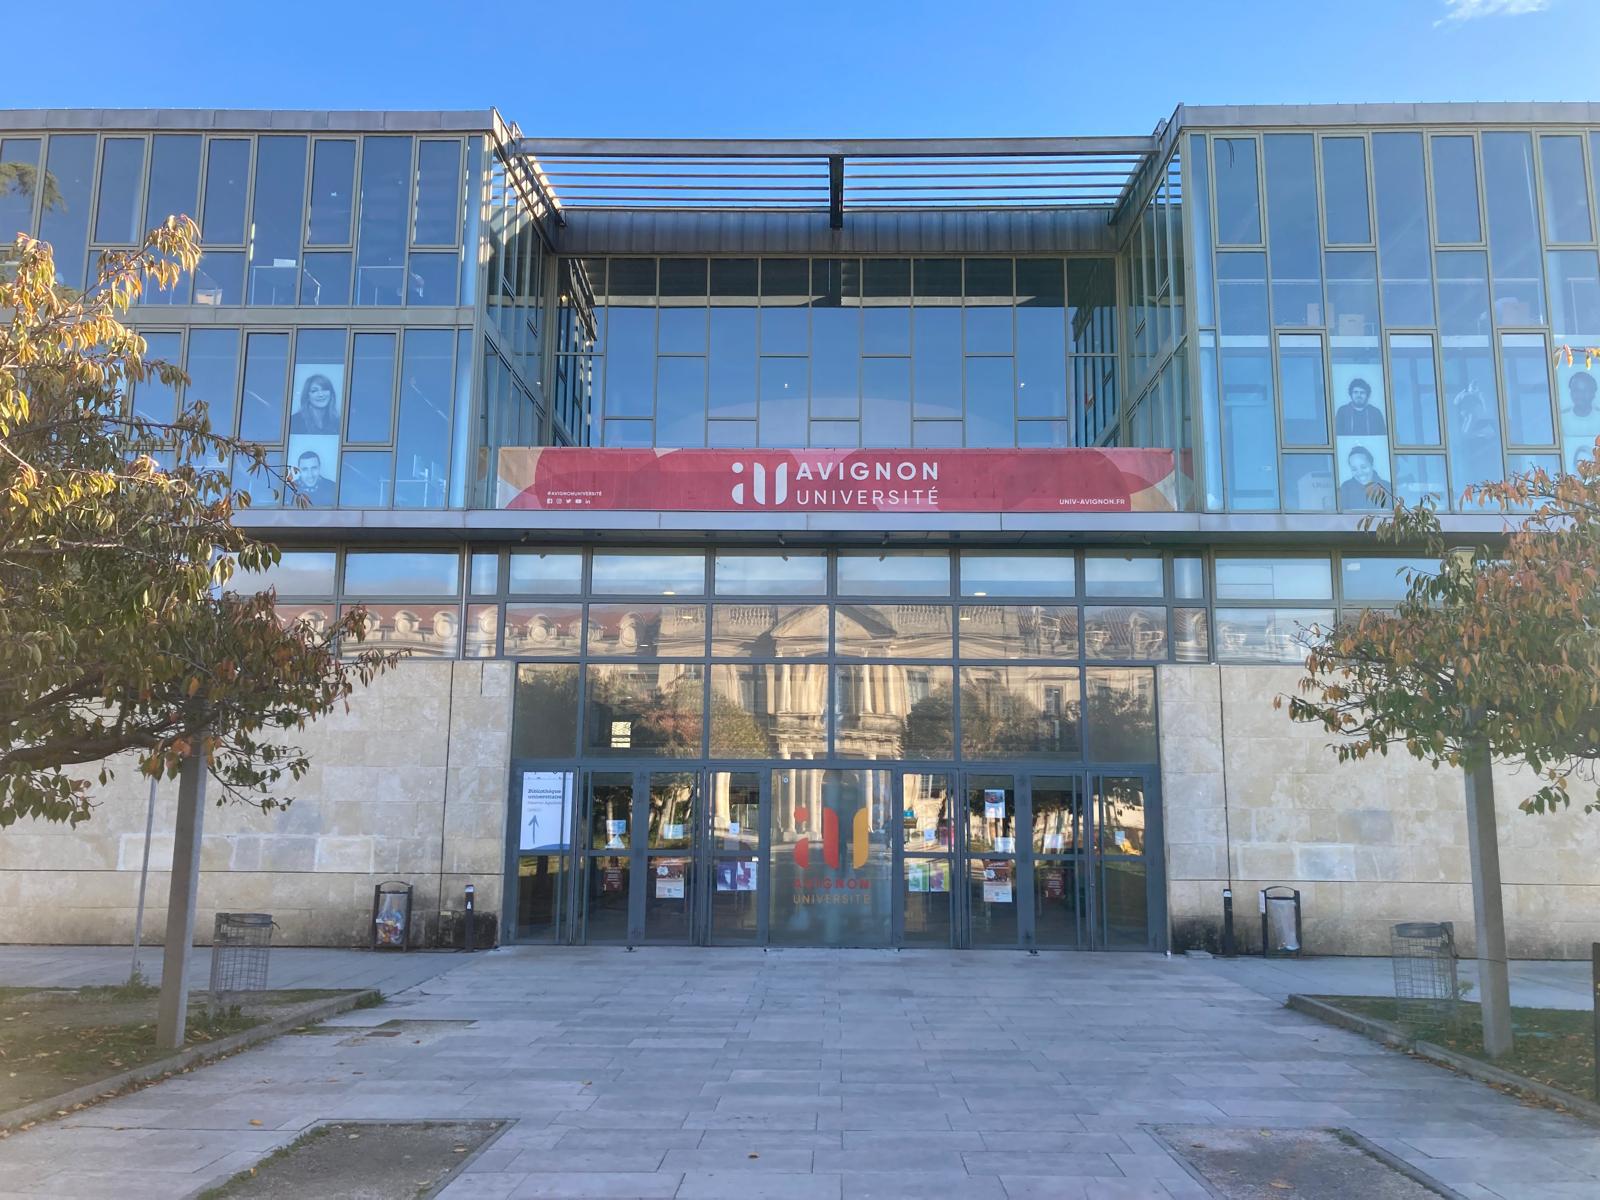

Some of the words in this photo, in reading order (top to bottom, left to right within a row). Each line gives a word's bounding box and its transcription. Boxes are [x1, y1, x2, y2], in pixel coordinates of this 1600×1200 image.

[796, 462, 938, 481] AVIGNON
[797, 486, 939, 505] UNIVERSITÉ
[793, 878, 871, 890] AVIGNON
